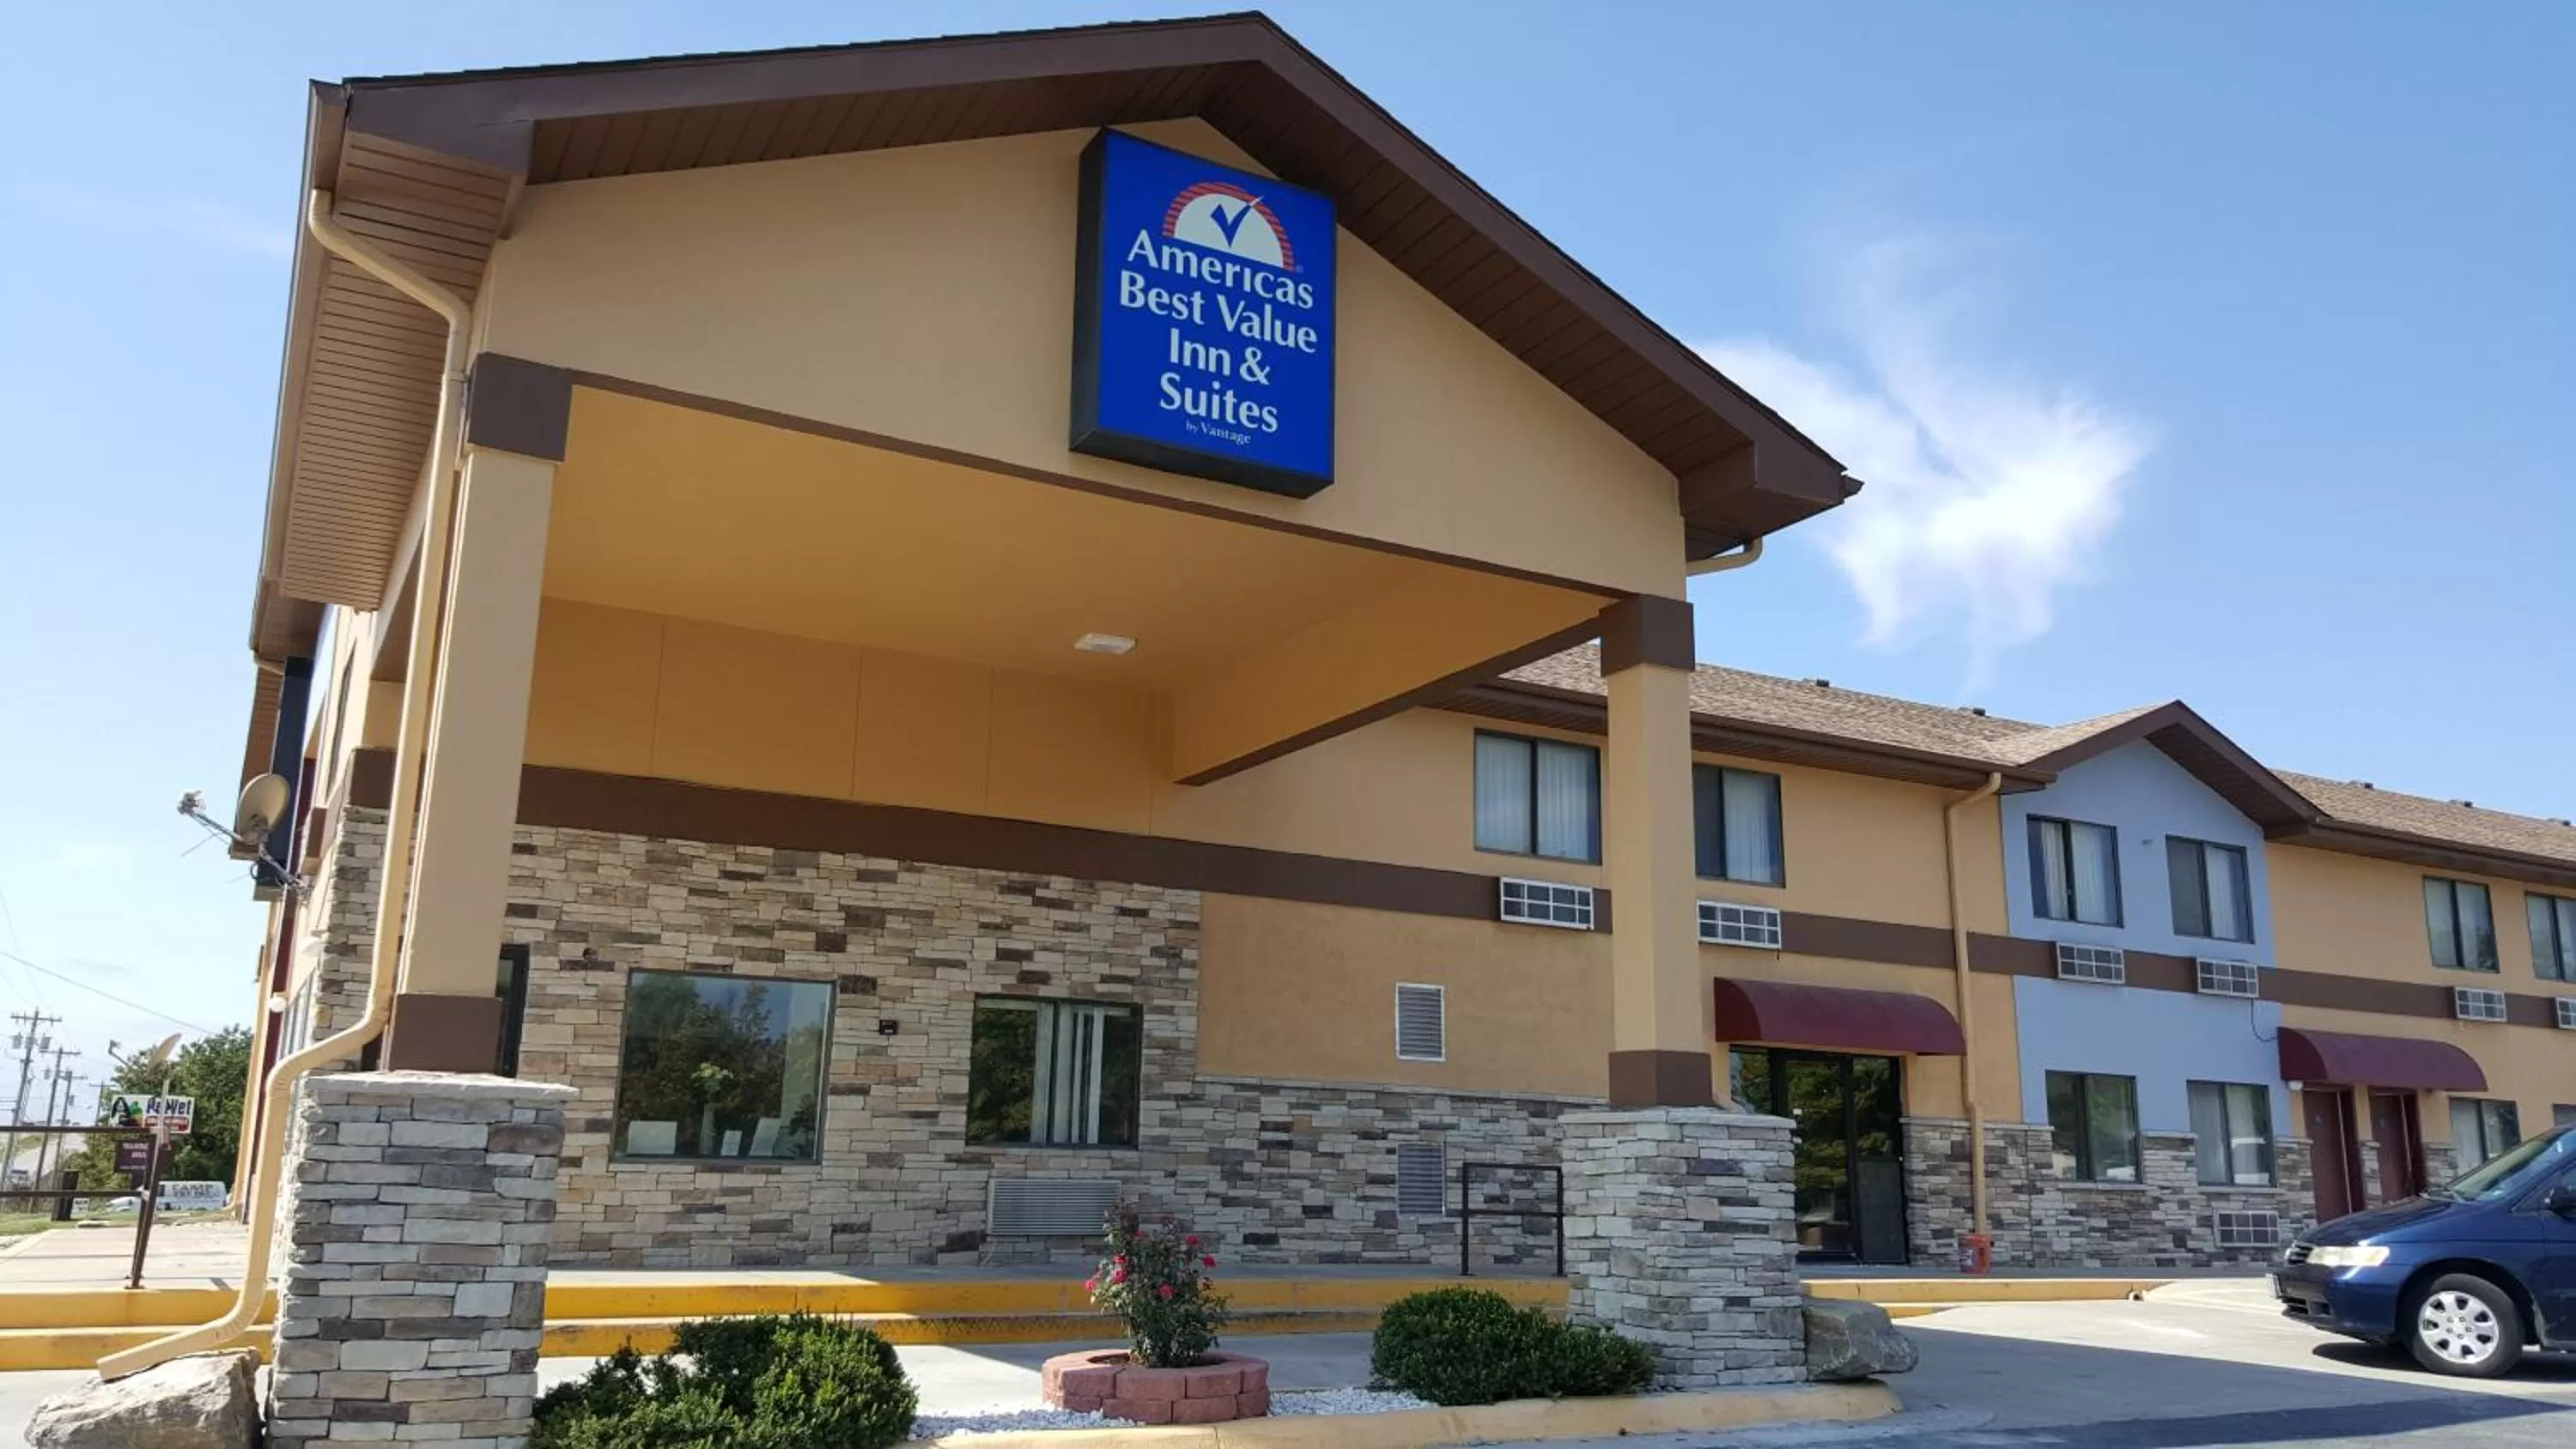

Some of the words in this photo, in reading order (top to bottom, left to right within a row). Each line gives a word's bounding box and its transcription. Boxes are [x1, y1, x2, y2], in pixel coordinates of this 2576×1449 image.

[1127, 229, 1313, 309] Americas
[1121, 270, 1205, 324] Best
[1217, 294, 1317, 353] Value
[1170, 328, 1230, 376] Inn
[1239, 347, 1270, 385] &
[1160, 373, 1278, 433] Suites
[1185, 419, 1200, 435] by
[1200, 421, 1251, 446] Vantage
